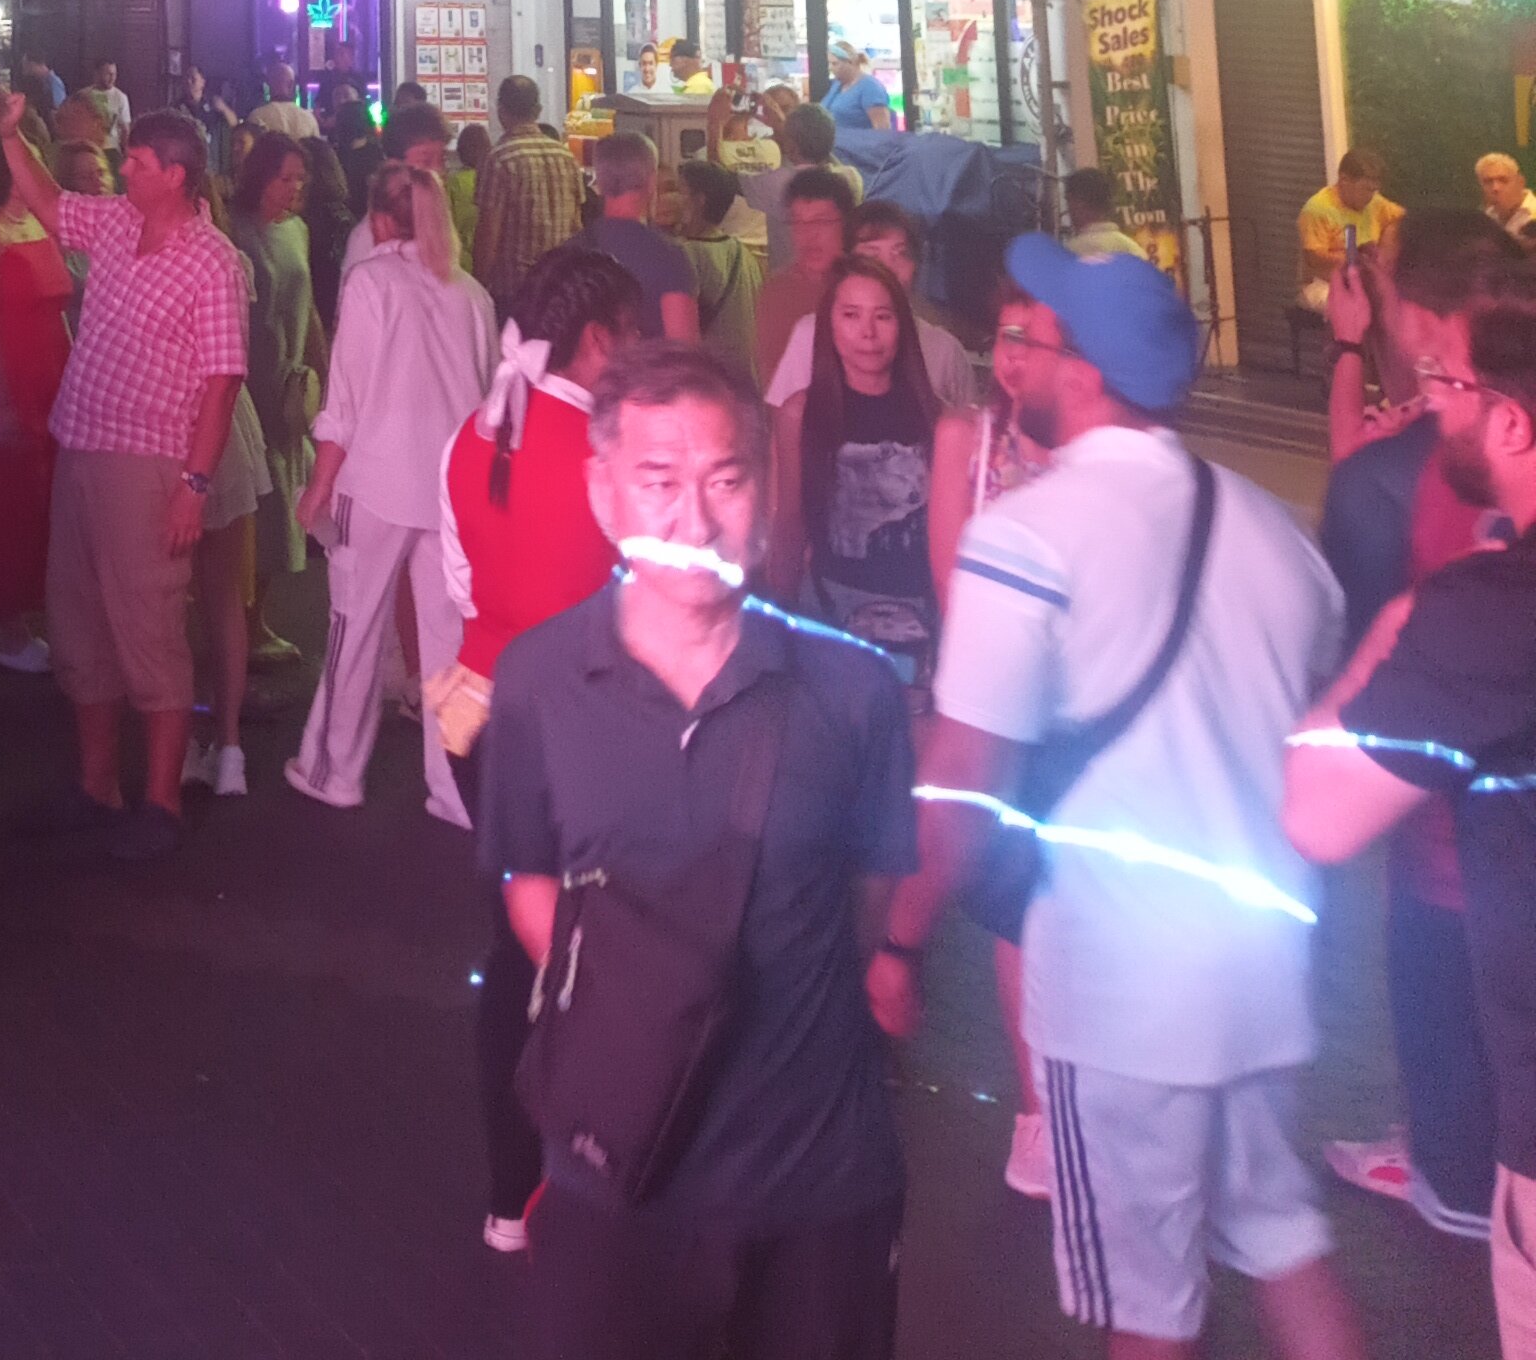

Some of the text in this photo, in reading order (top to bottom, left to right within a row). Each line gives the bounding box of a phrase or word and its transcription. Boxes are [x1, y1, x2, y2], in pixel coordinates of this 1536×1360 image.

[1098, 26, 1151, 55] Sales
[1106, 71, 1151, 92] Best
[1105, 105, 1159, 127] Price
[1115, 205, 1167, 226] Town
